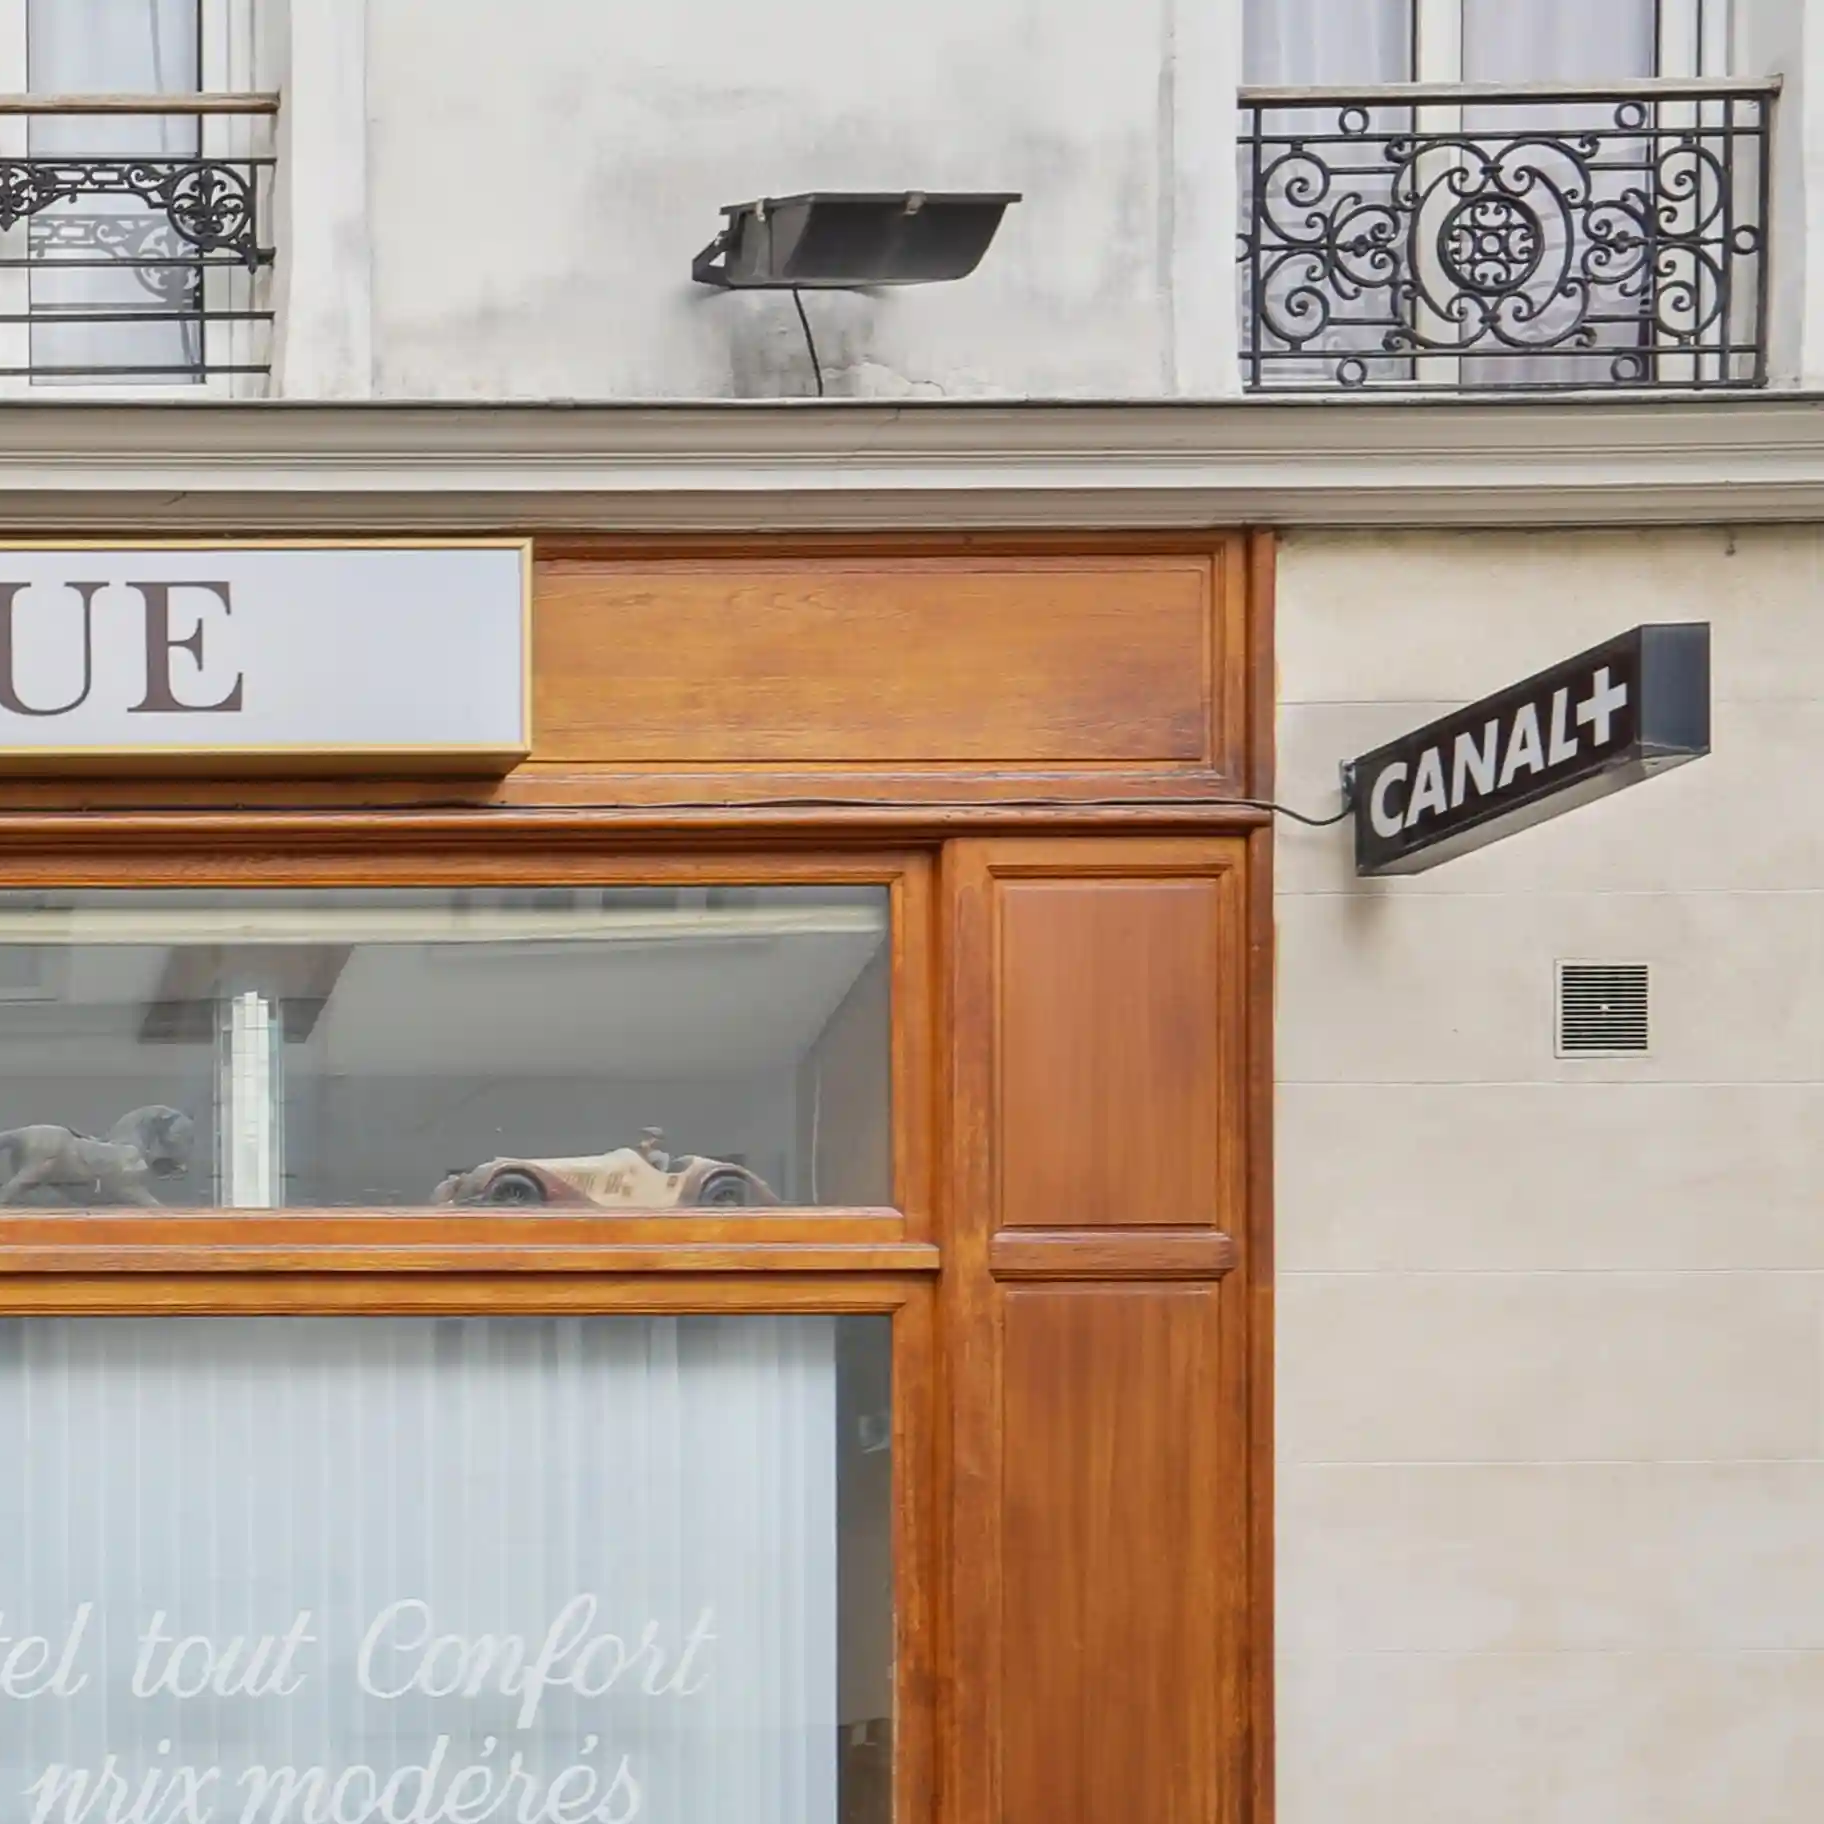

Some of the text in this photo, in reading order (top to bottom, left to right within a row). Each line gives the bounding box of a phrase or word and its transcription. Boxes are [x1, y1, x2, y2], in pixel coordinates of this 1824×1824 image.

[1369, 666, 1628, 838] CANAL+
[130, 1609, 318, 1699] tout
[357, 1592, 718, 1730] Confort
